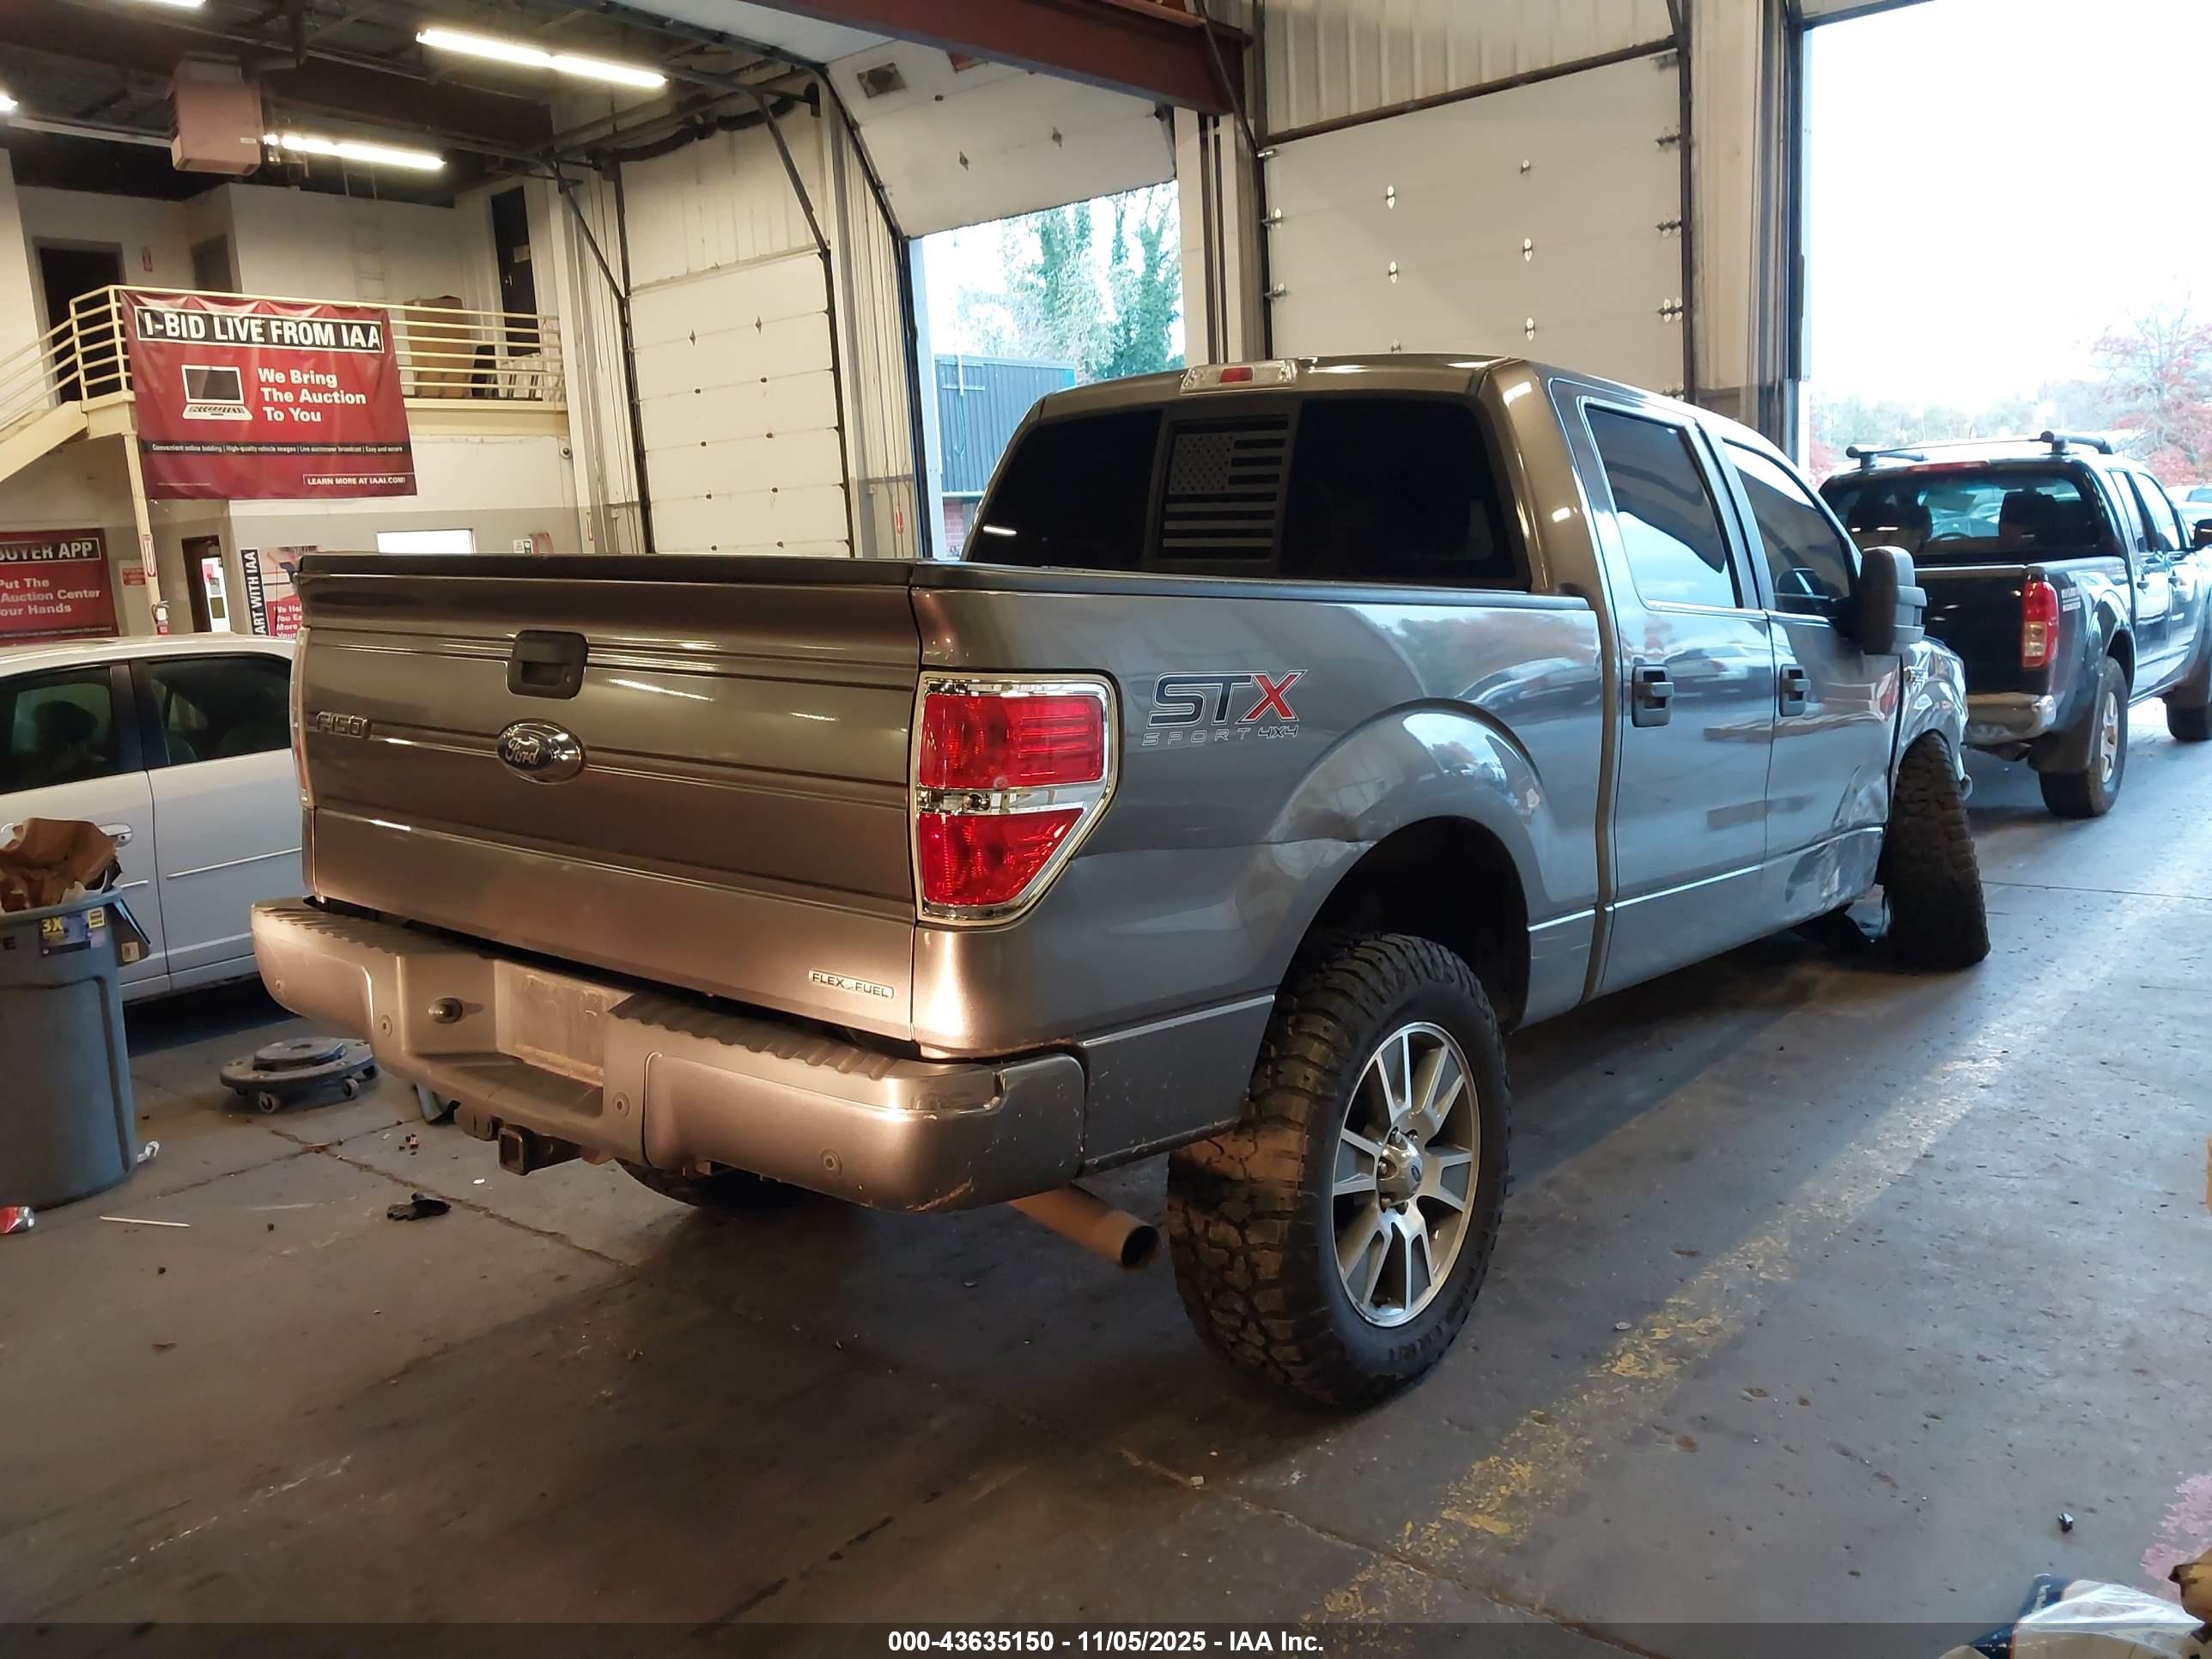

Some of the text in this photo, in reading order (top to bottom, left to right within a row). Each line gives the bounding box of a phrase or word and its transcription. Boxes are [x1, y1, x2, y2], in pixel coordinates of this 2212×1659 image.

[144, 312, 380, 348] I-BID LIVE FROM IAA
[258, 367, 337, 388] We Bring
[260, 387, 367, 405] The Auction
[262, 406, 322, 422] To You
[307, 477, 333, 485] LEARN
[335, 477, 357, 485] MORE
[58, 542, 93, 559] APP
[23, 578, 50, 588] The
[1, 589, 100, 603] Auction Center
[244, 551, 267, 635] ART WITH IAA
[0, 603, 72, 617] our Hands
[1146, 669, 1309, 729] STX
[1141, 727, 1251, 746] SPORT
[505, 736, 540, 765] Ford
[812, 972, 890, 998] FLEX FUEL
